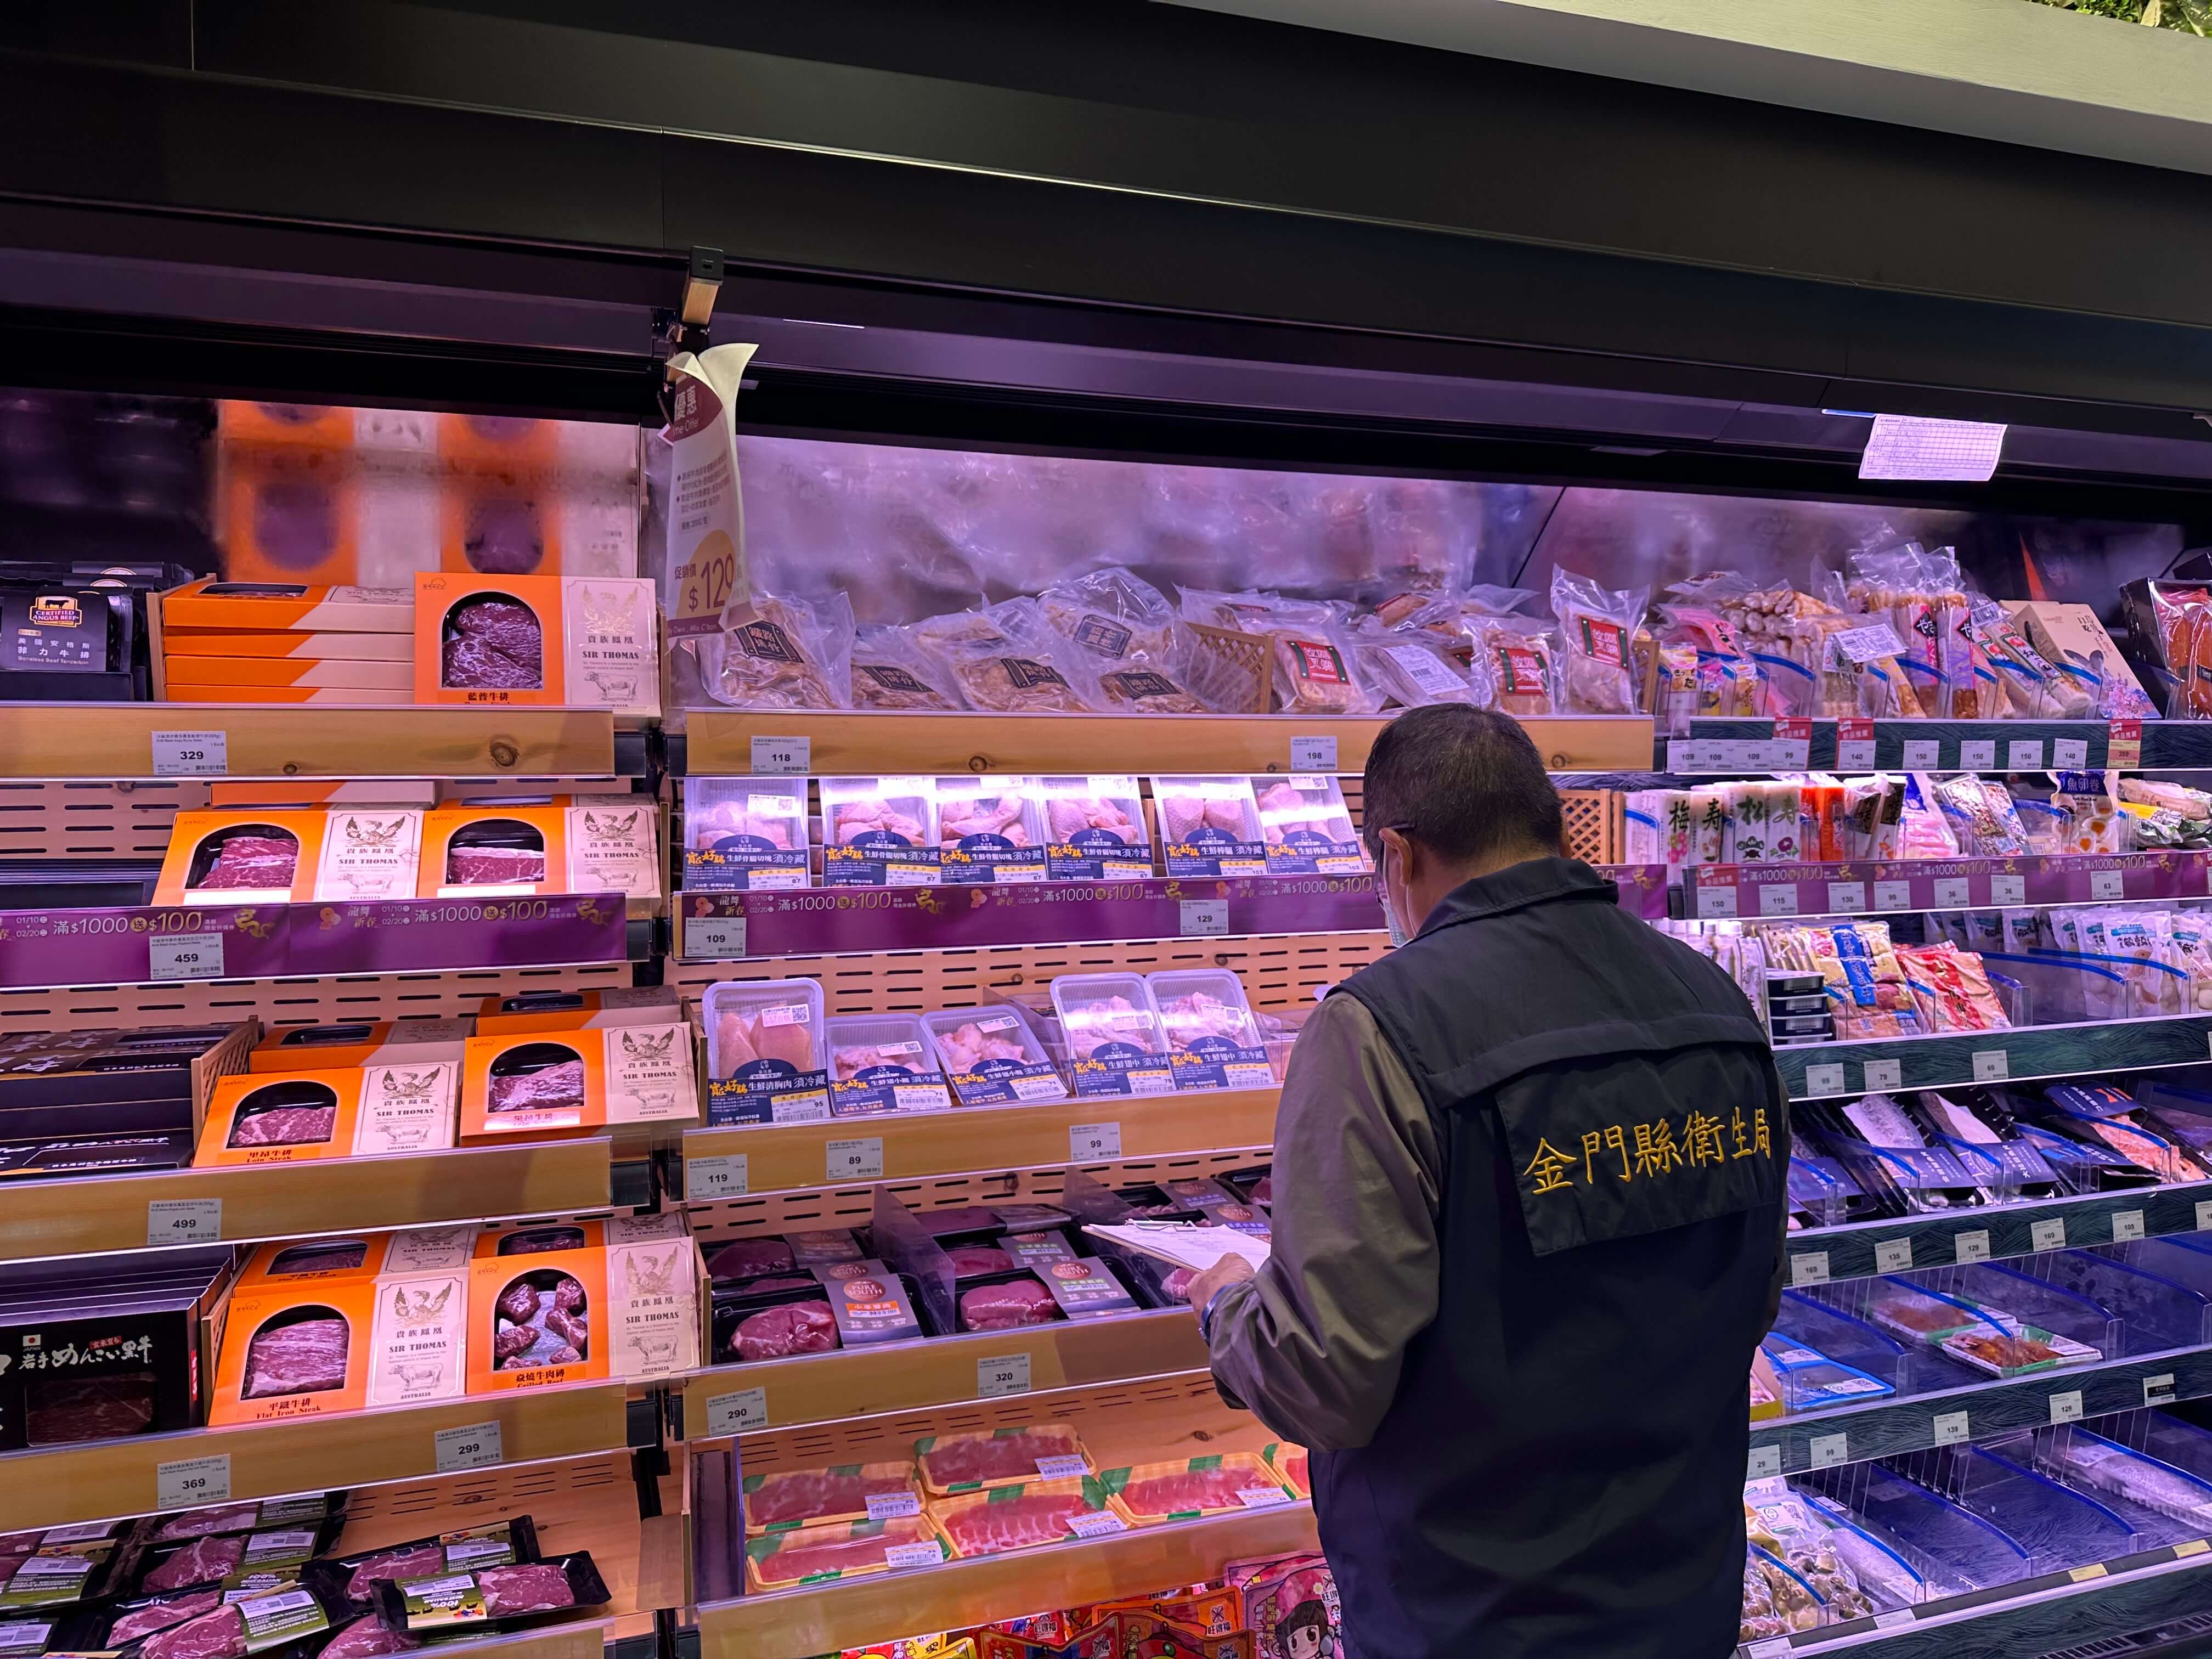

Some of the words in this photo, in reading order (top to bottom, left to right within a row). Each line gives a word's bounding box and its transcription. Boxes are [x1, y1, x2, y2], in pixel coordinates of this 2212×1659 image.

[685, 418, 701, 431] Offer
[18, 637, 90, 649] 美國安格斯
[588, 635, 634, 645] 貴族鳳凰
[18, 646, 90, 659] 菲力牛排
[603, 651, 639, 659] THOMAS
[467, 692, 509, 701] 藍普牛排
[180, 751, 204, 760] 329
[2067, 777, 2101, 792] 魚卵卷
[1736, 795, 1763, 826] 松
[1669, 801, 1690, 833] 梅
[1083, 847, 1122, 858] 生鮮骨腿切塊
[1122, 847, 1150, 859] 須冷藏
[1201, 845, 1233, 856] 生鮮棒腿
[1235, 844, 1263, 855] 須冷藏
[1297, 844, 1329, 856] 生鮮棒腿
[1331, 843, 1358, 855] 須冷藏
[726, 851, 772, 864] 生鮮骨腿切塊
[772, 852, 805, 864] 須冷藏
[865, 850, 907, 862] 生鮮骨腿切塊
[907, 851, 940, 862] 須冷藏
[972, 851, 1013, 863] 生鮮骨腿切塊
[1012, 850, 1043, 861] 須冷藏
[719, 895, 740, 906] 龍舞
[382, 905, 403, 913] 01/10
[725, 905, 745, 917] 新春
[16, 916, 39, 924] 01/10
[382, 917, 403, 926] 02/20
[1197, 915, 1213, 923] 129
[16, 929, 40, 938] 02/20
[706, 934, 726, 943] 109
[174, 952, 199, 963] 459
[1204, 1051, 1235, 1062] 生鮮翅中
[1108, 1057, 1140, 1069] 生鮮翅中
[748, 1080, 792, 1092] 生鮮清胸肉
[793, 1074, 826, 1088] 須冷藏
[1090, 1139, 1102, 1148] 99
[1523, 1106, 1771, 1194] 金門縣衛生局
[849, 1156, 861, 1165] 89
[708, 1173, 728, 1184] 119
[173, 1219, 196, 1229] 499
[848, 1288, 882, 1296] SOUTH
[630, 1295, 674, 1308] 貴族鳳凰
[626, 1315, 642, 1324] SIR
[644, 1311, 679, 1323] THOMAS
[396, 1327, 442, 1338] 貴族鳳凰
[389, 1344, 405, 1353] SIR
[409, 1341, 447, 1351] THOMAS
[995, 1372, 1013, 1382] 320
[400, 1391, 431, 1400] AUSTRALIA
[269, 1398, 311, 1410] 平鐵牛排
[298, 1406, 321, 1414] Steak
[727, 1408, 748, 1420] 290
[458, 1443, 480, 1455] 299
[182, 1478, 206, 1489] 369
[1322, 1589, 1338, 1601] 旺得
[1035, 1621, 1057, 1634] 旺得福
[1208, 1622, 1232, 1636] 旺得福
